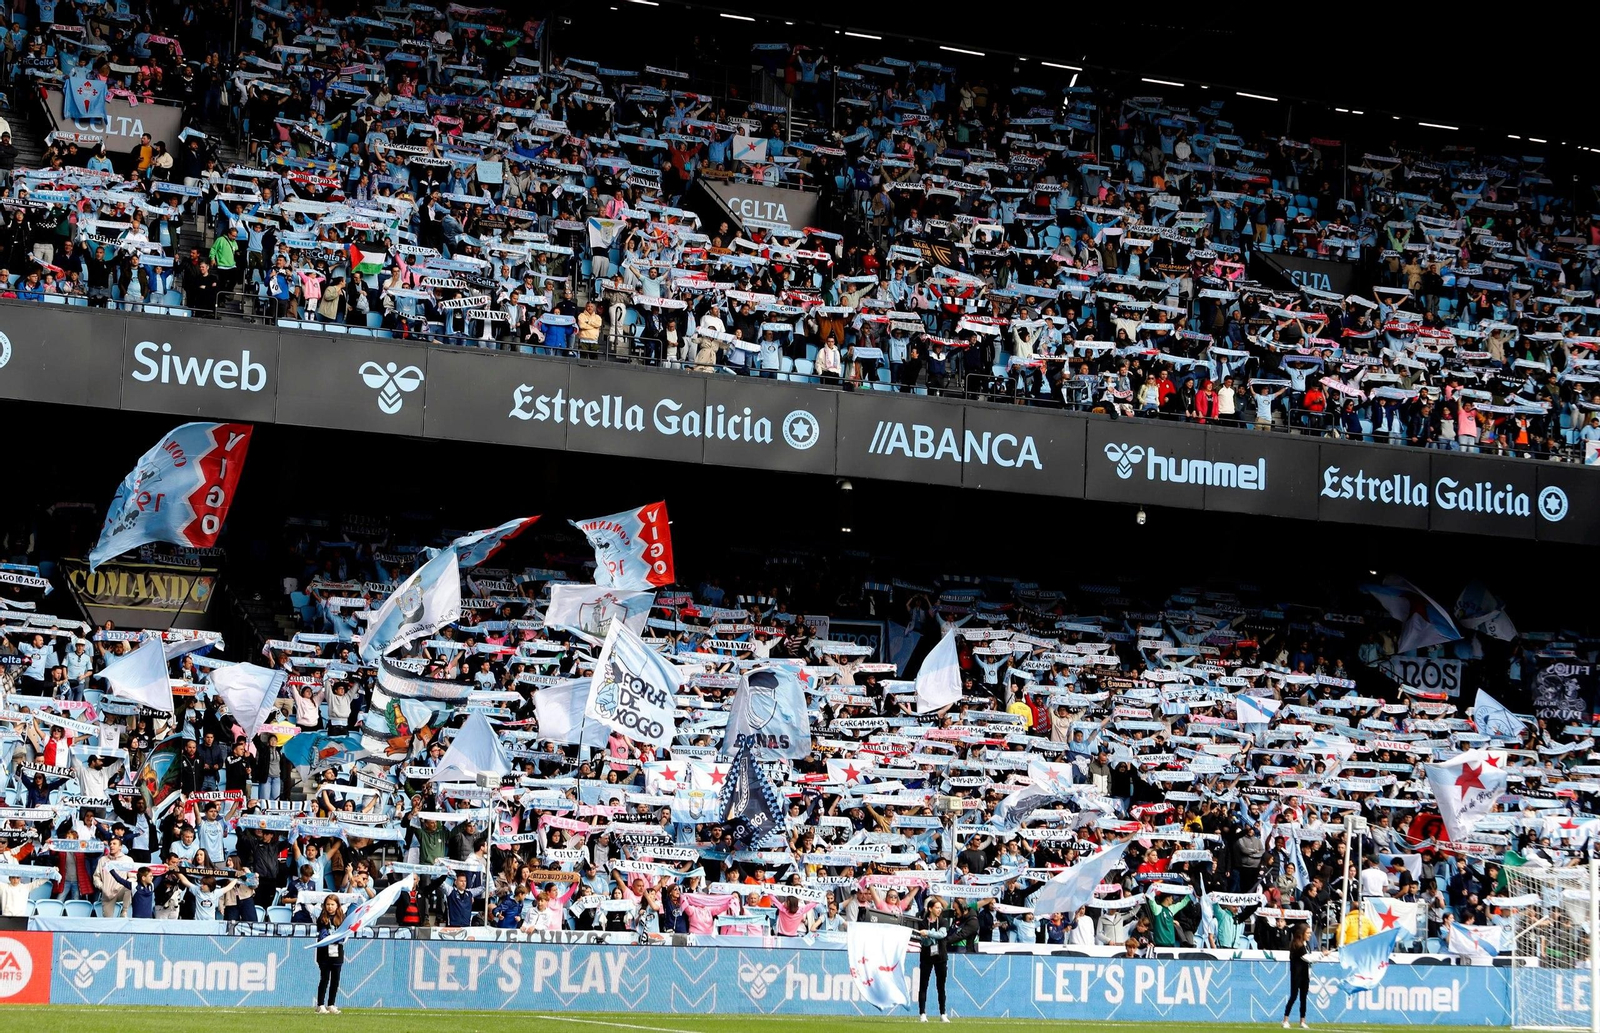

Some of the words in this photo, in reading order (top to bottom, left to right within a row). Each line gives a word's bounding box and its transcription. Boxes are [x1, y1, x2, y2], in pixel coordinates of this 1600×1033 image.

[727, 197, 789, 222] CELTA
[131, 340, 267, 392] Siweb
[508, 382, 646, 433] Estrella
[652, 397, 774, 444] Galicia
[884, 421, 1043, 470] ABANCA
[1146, 446, 1267, 491] hummel
[1321, 465, 1430, 507] Estrella
[1434, 475, 1532, 517] Galicia
[69, 569, 211, 602] COMANDO
[620, 688, 641, 711] DE
[622, 674, 668, 710] FORA
[612, 708, 665, 740] XOGO
[839, 718, 886, 728] CARCAMANS
[942, 884, 964, 893] CORVOS
[965, 885, 989, 893] CELESTES
[114, 950, 277, 992] hummel
[412, 947, 523, 993] LET'S
[532, 949, 627, 995] PLAY
[1034, 963, 1125, 1003] LET'S
[1134, 964, 1213, 1005] PLAY
